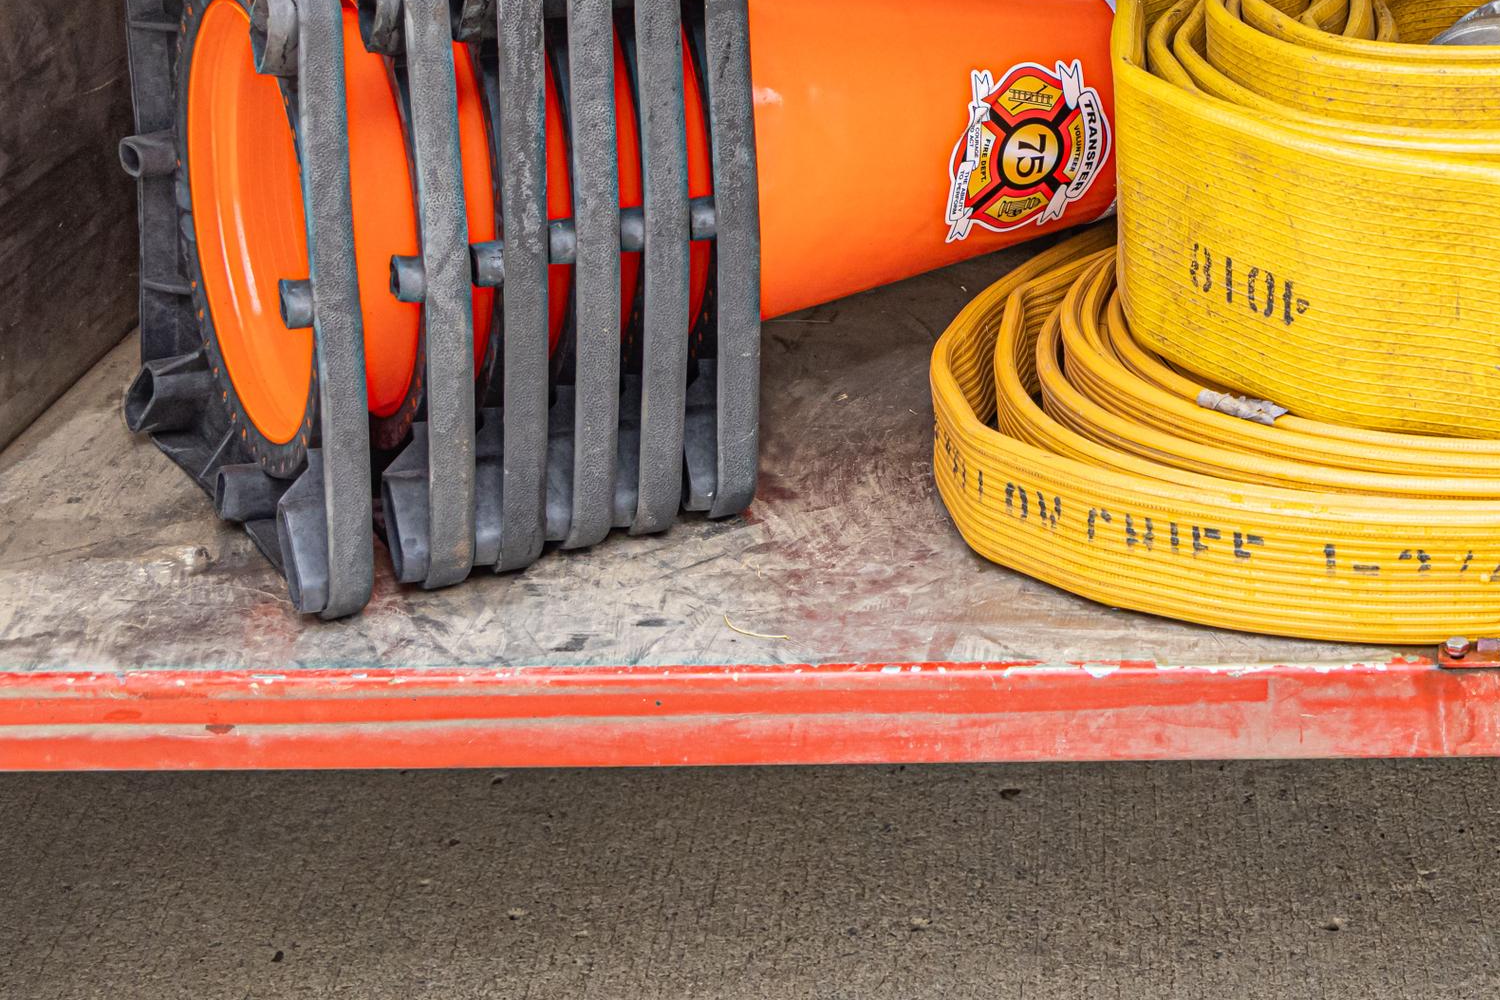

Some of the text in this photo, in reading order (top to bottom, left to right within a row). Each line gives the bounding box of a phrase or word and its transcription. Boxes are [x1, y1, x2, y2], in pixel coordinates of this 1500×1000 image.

[981, 138, 991, 158] FIRE
[1016, 133, 1047, 178] 75
[1068, 124, 1082, 172] VOLUNTEER
[1071, 99, 1098, 192] TRANSFER
